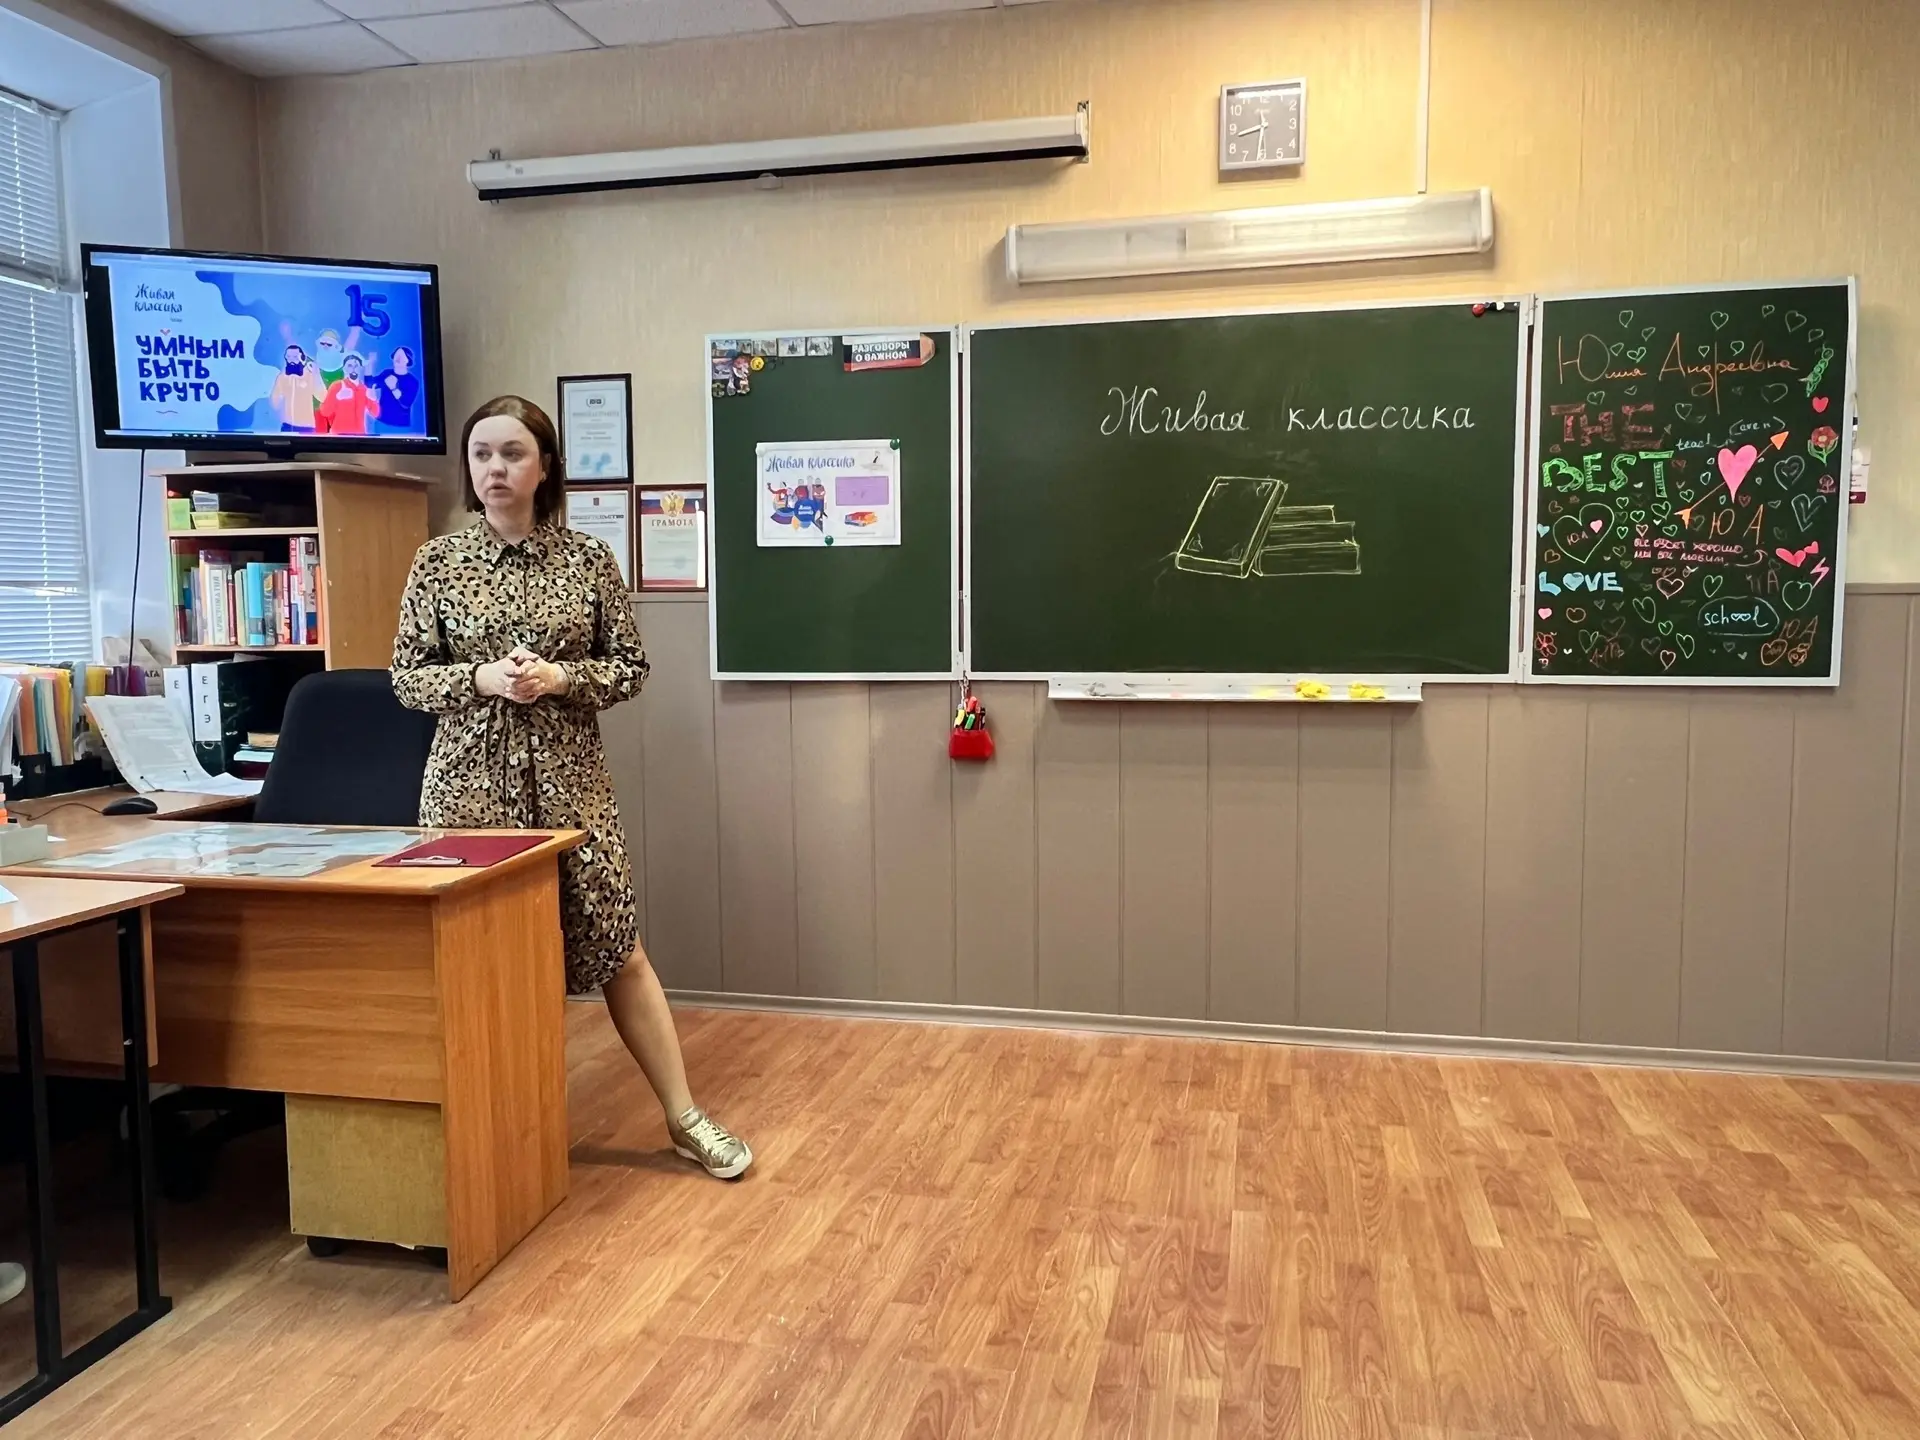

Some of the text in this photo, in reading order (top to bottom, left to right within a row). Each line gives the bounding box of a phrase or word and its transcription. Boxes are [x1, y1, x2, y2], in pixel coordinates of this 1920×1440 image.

[1230, 104, 1242, 116] 10
[1288, 100, 1297, 112] 2
[1229, 123, 1237, 135] 9
[1288, 117, 1297, 130] 3
[1229, 143, 1237, 154] 8
[1288, 138, 1296, 150] 4
[1242, 150, 1249, 162] 7
[1276, 147, 1284, 160] 5
[135, 283, 175, 300] Живая
[134, 301, 183, 314] классика
[345, 284, 391, 337] 15
[135, 335, 245, 360] УМНЫМ
[852, 341, 910, 353] РАЗГОВОРЫ
[855, 350, 908, 363] О ВАЖНОМ
[1557, 333, 1647, 385] Юлия
[137, 357, 211, 380] БЫТЬ
[139, 381, 220, 403] КРУТО
[1100, 385, 1475, 436] Живая классика
[1549, 403, 1664, 450] THE
[765, 455, 805, 473] Живая
[807, 455, 856, 470] классика
[1541, 450, 1675, 500] BEST
[651, 518, 695, 527] ГРАМОТА
